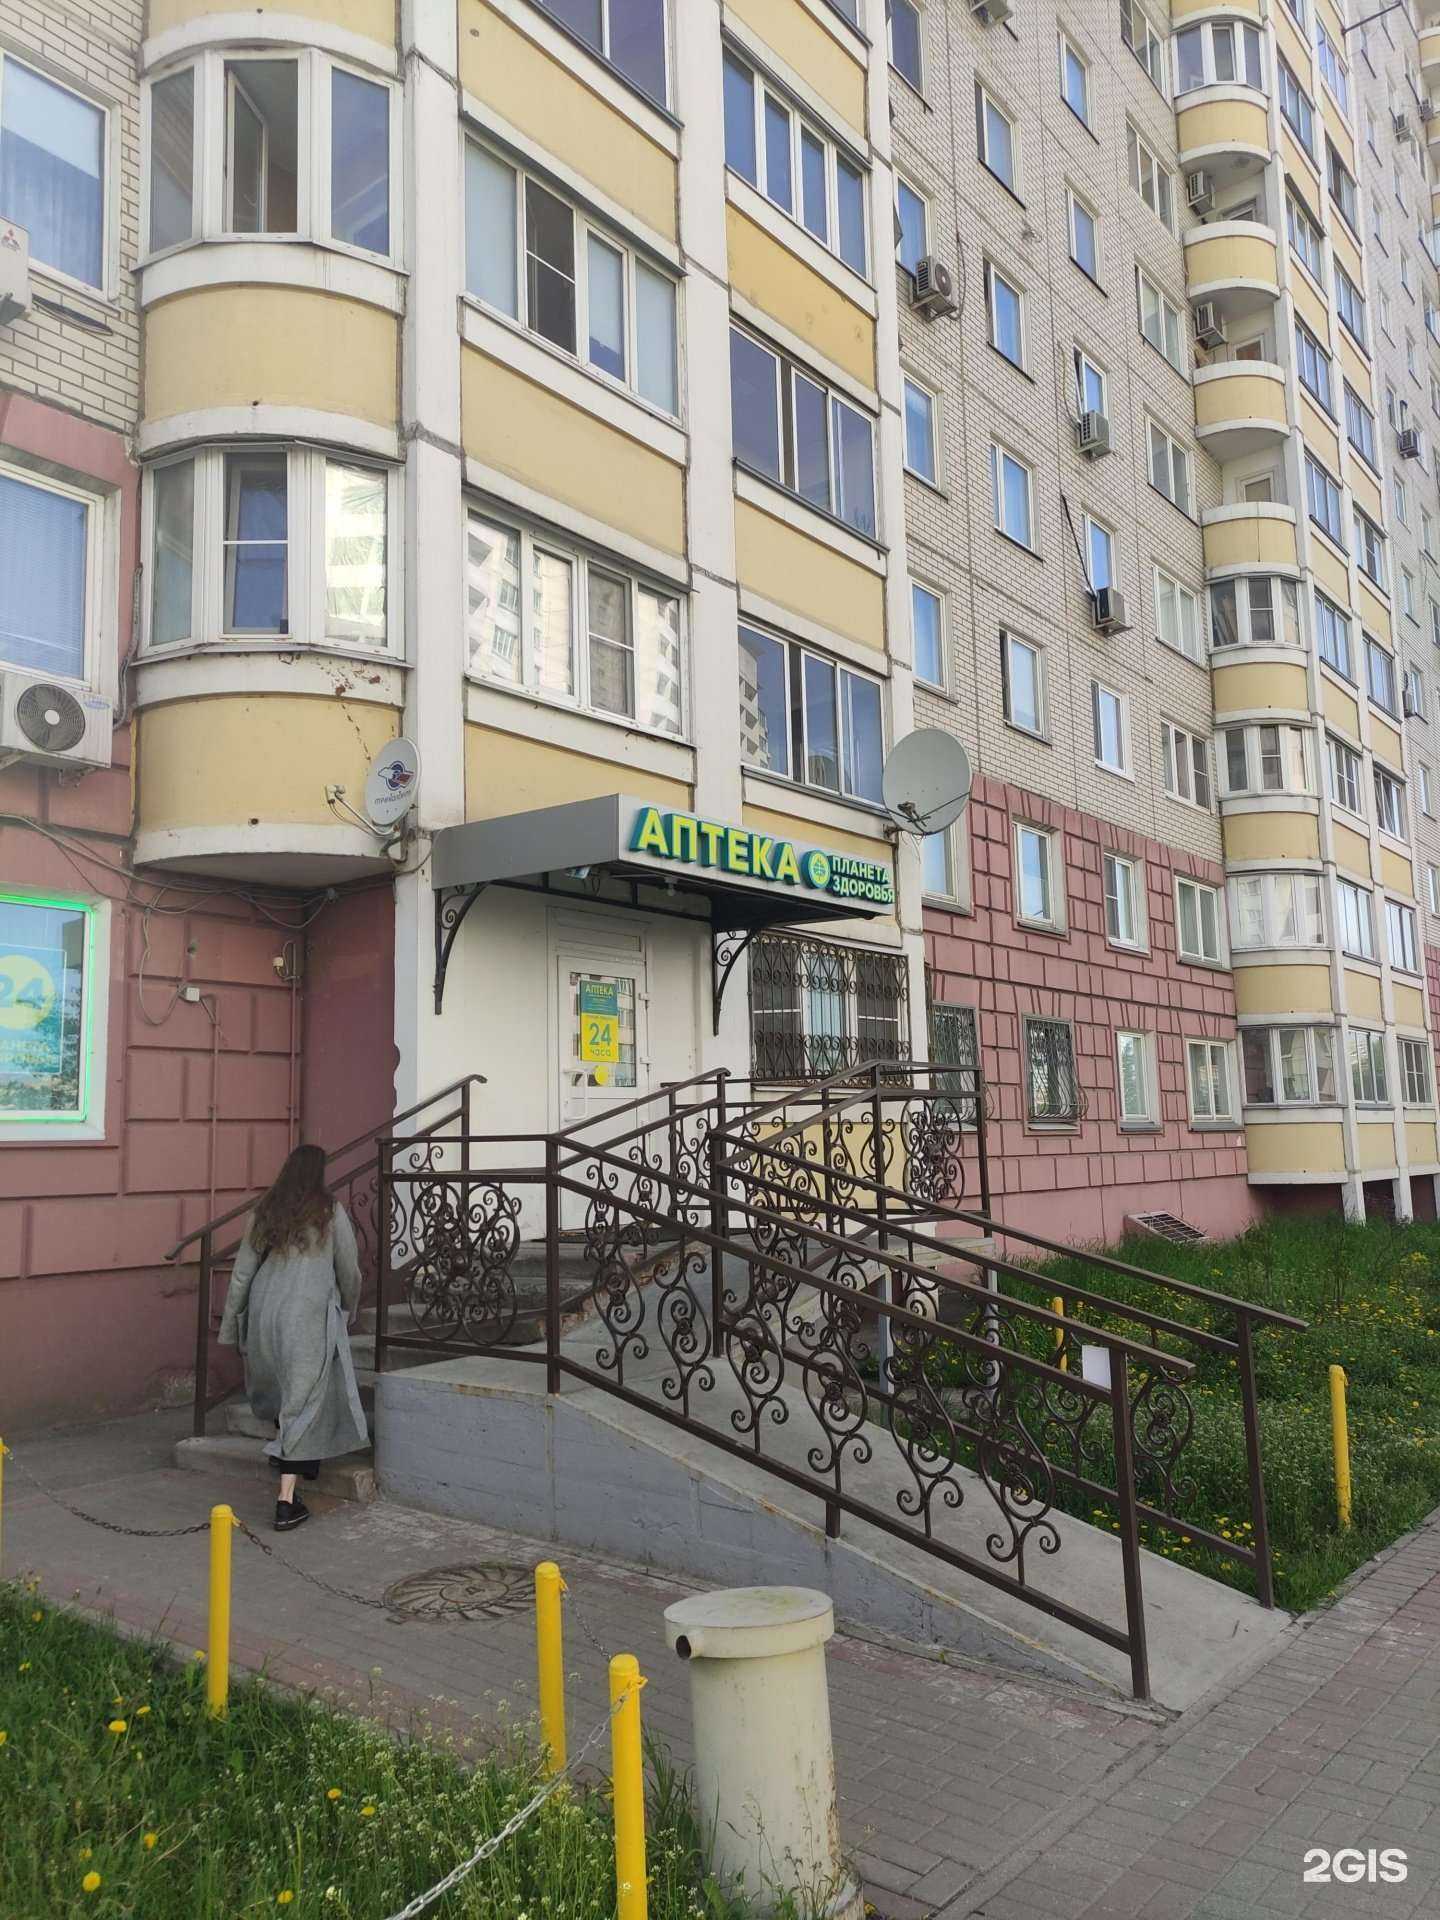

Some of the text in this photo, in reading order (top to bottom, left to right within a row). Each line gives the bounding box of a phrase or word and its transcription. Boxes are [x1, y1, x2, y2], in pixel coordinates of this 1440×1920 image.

[632, 806, 800, 884] АПТЕКА
[831, 856, 891, 885] ПЛАНЕТА
[832, 877, 895, 904] ЗДОРОВЬЯ
[589, 1022, 612, 1046] 24
